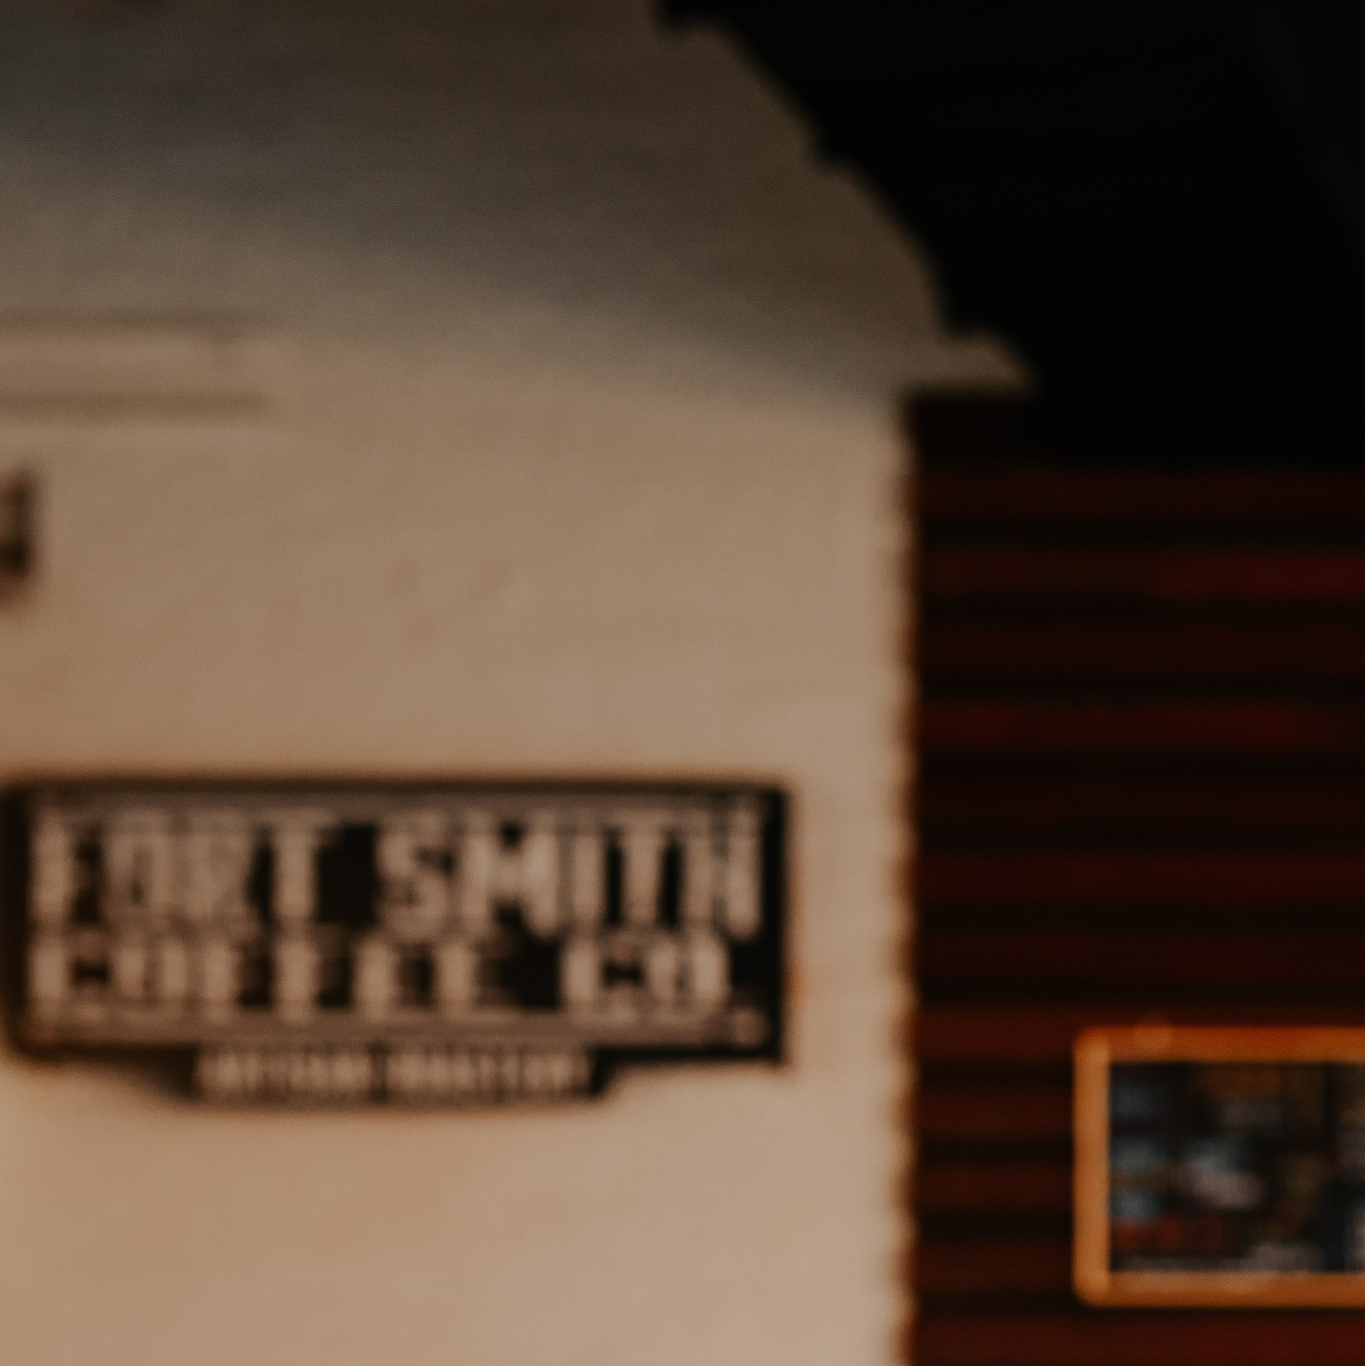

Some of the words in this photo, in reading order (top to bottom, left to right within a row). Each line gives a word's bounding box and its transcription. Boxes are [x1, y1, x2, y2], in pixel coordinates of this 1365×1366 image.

[28, 806, 340, 928] FORT
[374, 802, 764, 936] SMITH
[28, 928, 512, 1024] COFFEE
